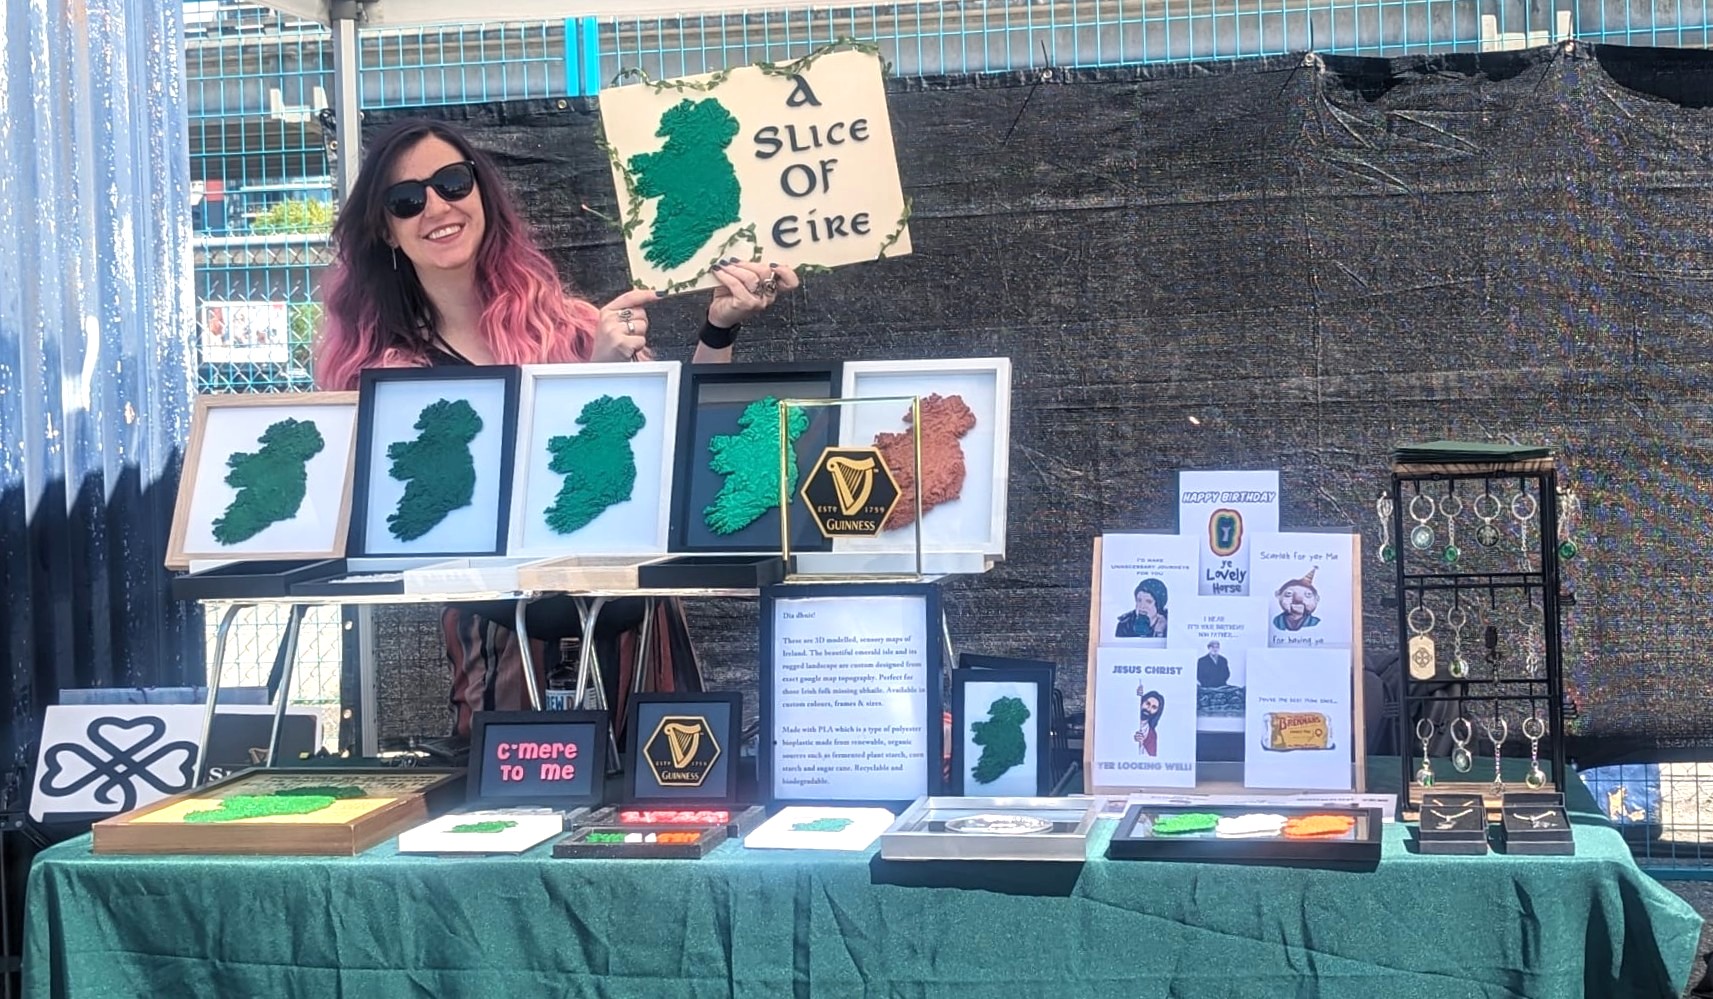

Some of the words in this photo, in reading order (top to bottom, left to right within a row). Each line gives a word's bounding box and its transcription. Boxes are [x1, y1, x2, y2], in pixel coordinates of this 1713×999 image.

[753, 118, 870, 159] SLICE
[780, 158, 838, 198] OF
[1182, 491, 1220, 504] HAPPY
[1220, 491, 1277, 504] BIRTHDAY
[1293, 552, 1306, 560] for
[1309, 554, 1323, 562] yer
[1326, 552, 1338, 560] Ma
[1220, 560, 1232, 569] ye
[1206, 568, 1247, 584] Lovely
[1212, 582, 1242, 595] Horse
[814, 636, 826, 644] 3D
[826, 636, 858, 644] modelled,
[885, 636, 902, 644] maps
[1288, 636, 1312, 646] having
[1315, 638, 1324, 646] ya
[824, 648, 854, 656] beautiful
[854, 648, 880, 656] emerald
[782, 662, 804, 670] rugged
[806, 662, 838, 670] landscape
[875, 661, 904, 670] designed
[1112, 666, 1142, 674] JESUS
[1144, 666, 1183, 675] CHRIST
[800, 676, 821, 684] google
[838, 675, 877, 683] topography.
[832, 688, 858, 696] missing
[806, 700, 834, 708] colours,
[868, 726, 882, 734] type
[892, 726, 922, 734] polyester
[782, 739, 814, 747] bioplastic
[850, 738, 886, 746] renewable,
[866, 752, 884, 760] plant
[782, 764, 802, 772] starch
[804, 764, 816, 772] and
[854, 764, 890, 772] Recyclable
[1098, 762, 1116, 770] YER
[1118, 762, 1162, 770] LOOKING
[782, 778, 830, 786] biodegradable.
